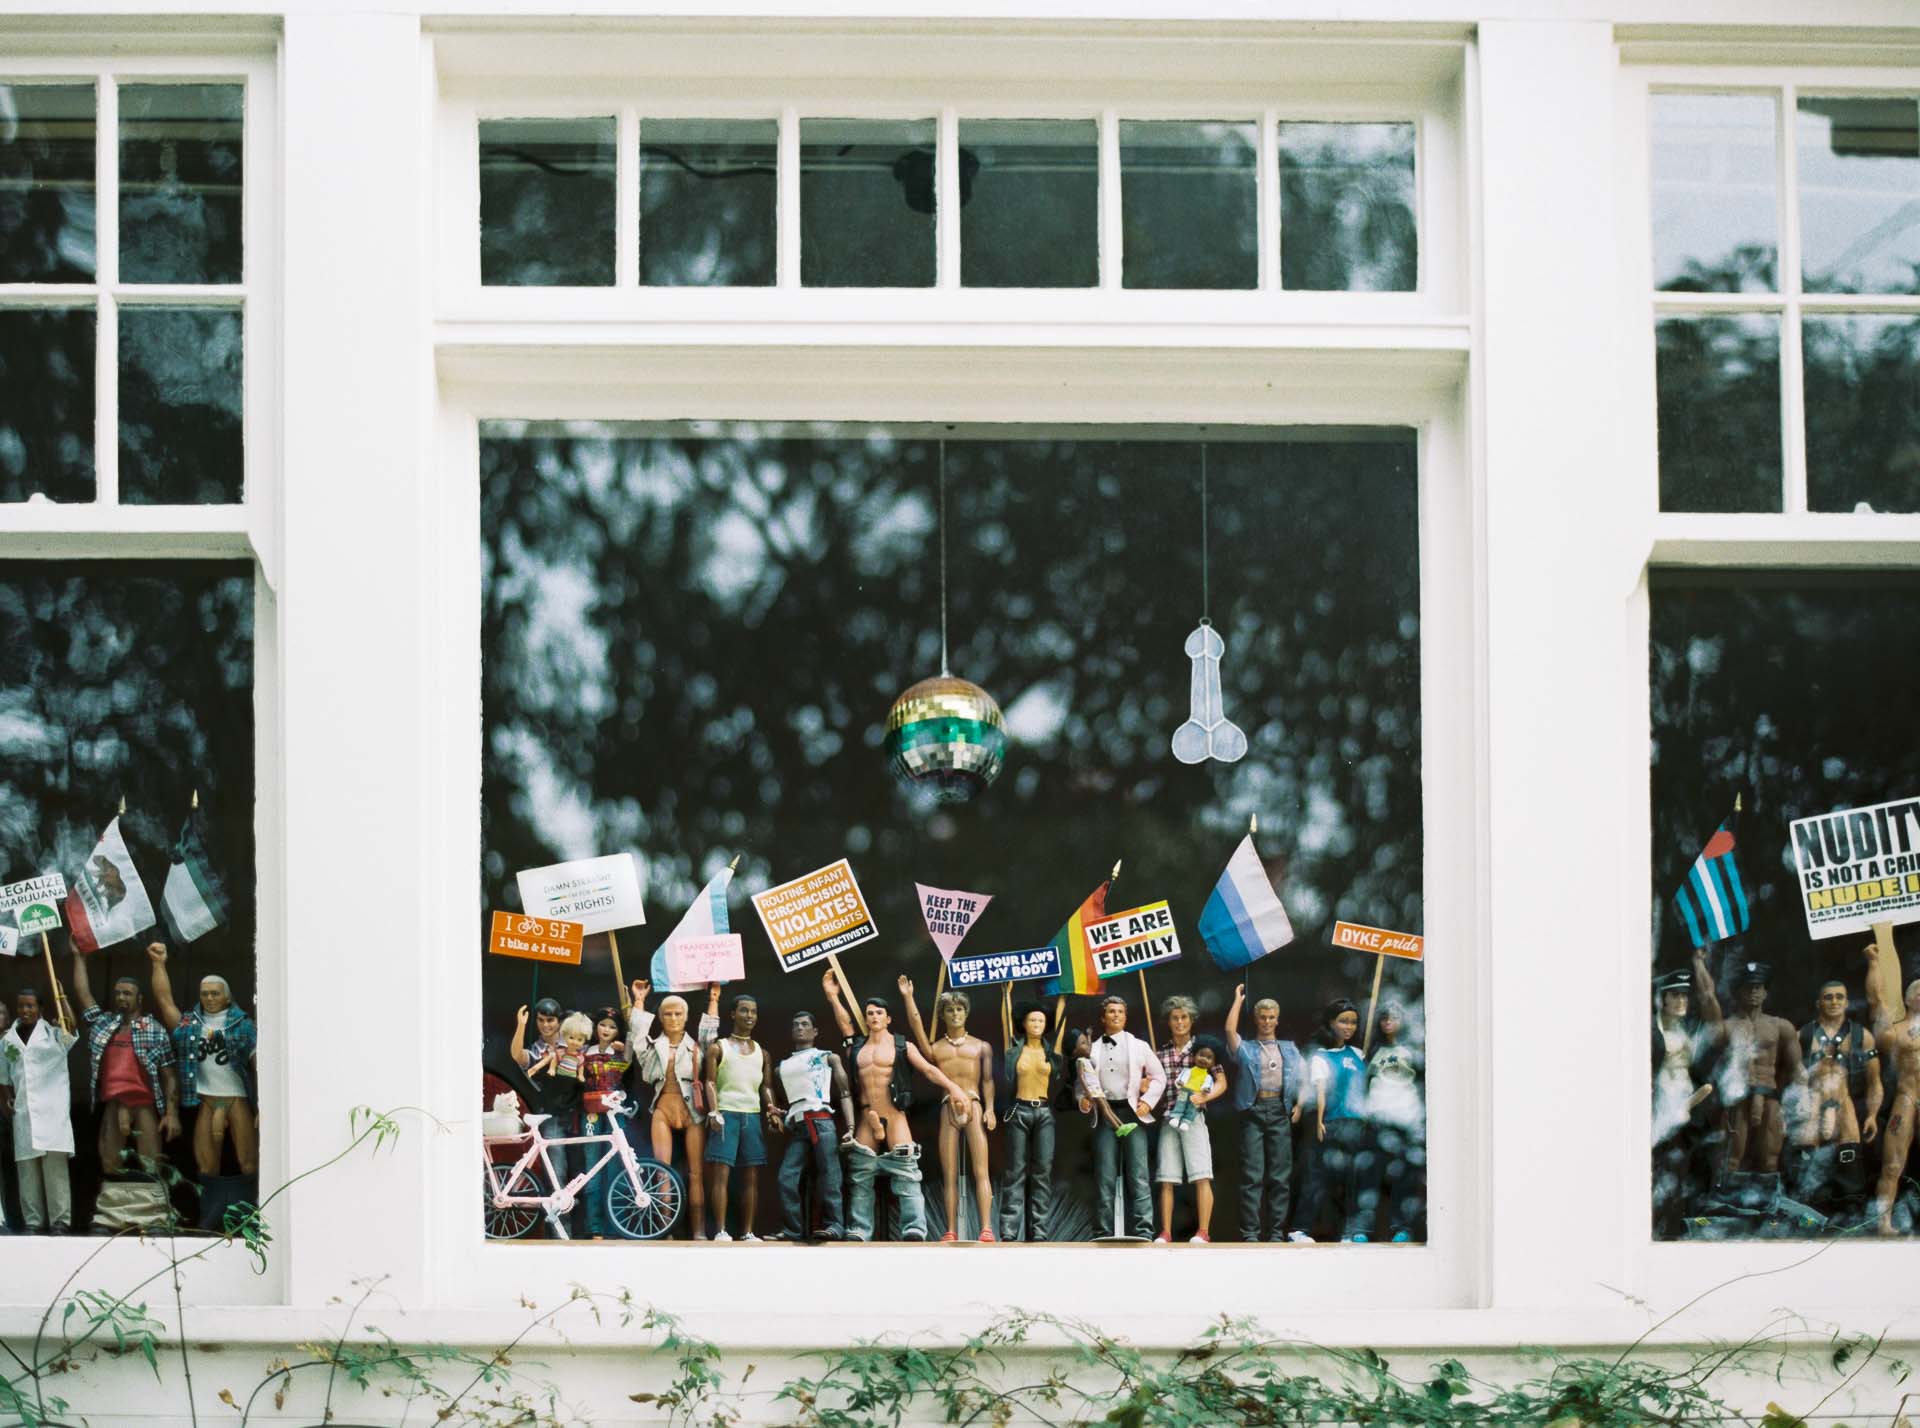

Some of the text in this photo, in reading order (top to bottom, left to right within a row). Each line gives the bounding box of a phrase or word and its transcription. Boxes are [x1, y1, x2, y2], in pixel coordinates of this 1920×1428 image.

[1804, 871, 1823, 889] IS
[1827, 864, 1862, 886] NOT
[1869, 861, 1880, 878] A
[1, 888, 66, 908] MARIJUANA
[761, 867, 844, 909] ROUTINE INFANT
[767, 880, 852, 920] CIRCUMCISION
[1807, 876, 1902, 911] NUDE
[550, 904, 571, 916] GAY
[927, 894, 976, 912] KEEP THE
[505, 915, 571, 939] I SF
[772, 893, 858, 938] VIOLATES
[927, 907, 970, 924] CASTRO
[1090, 909, 1170, 945] WE ARE
[779, 911, 864, 950] HUMAN RIGHTS
[930, 921, 965, 937] QUEER
[1341, 928, 1419, 952] DYKE pride
[499, 936, 571, 956] I bike & I vote
[785, 925, 870, 965] BAY AREA INTACTIVISTS
[1098, 936, 1173, 970] FAMILY
[952, 951, 1055, 973] KEEP YOUR LAWS
[960, 962, 1049, 983] OFF MY BODY
